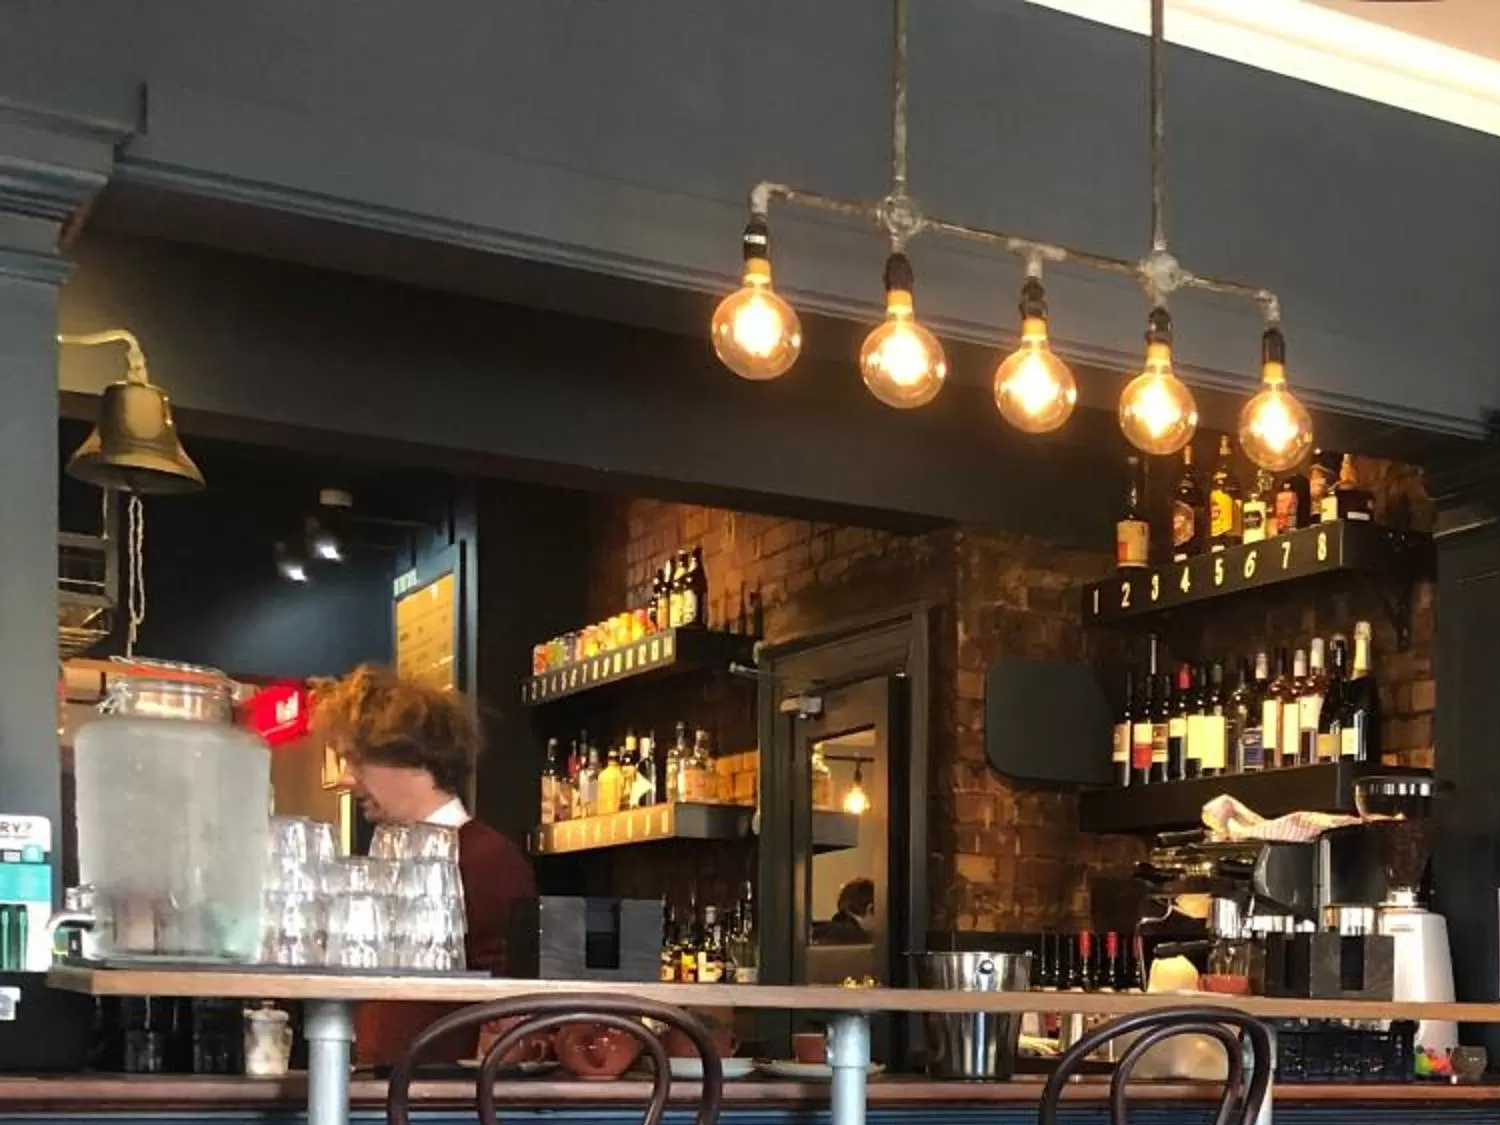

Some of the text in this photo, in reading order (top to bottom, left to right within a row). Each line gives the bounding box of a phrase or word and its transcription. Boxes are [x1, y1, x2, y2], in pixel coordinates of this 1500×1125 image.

[1093, 531, 1327, 614] 1 2 3 4 5 6 7 8
